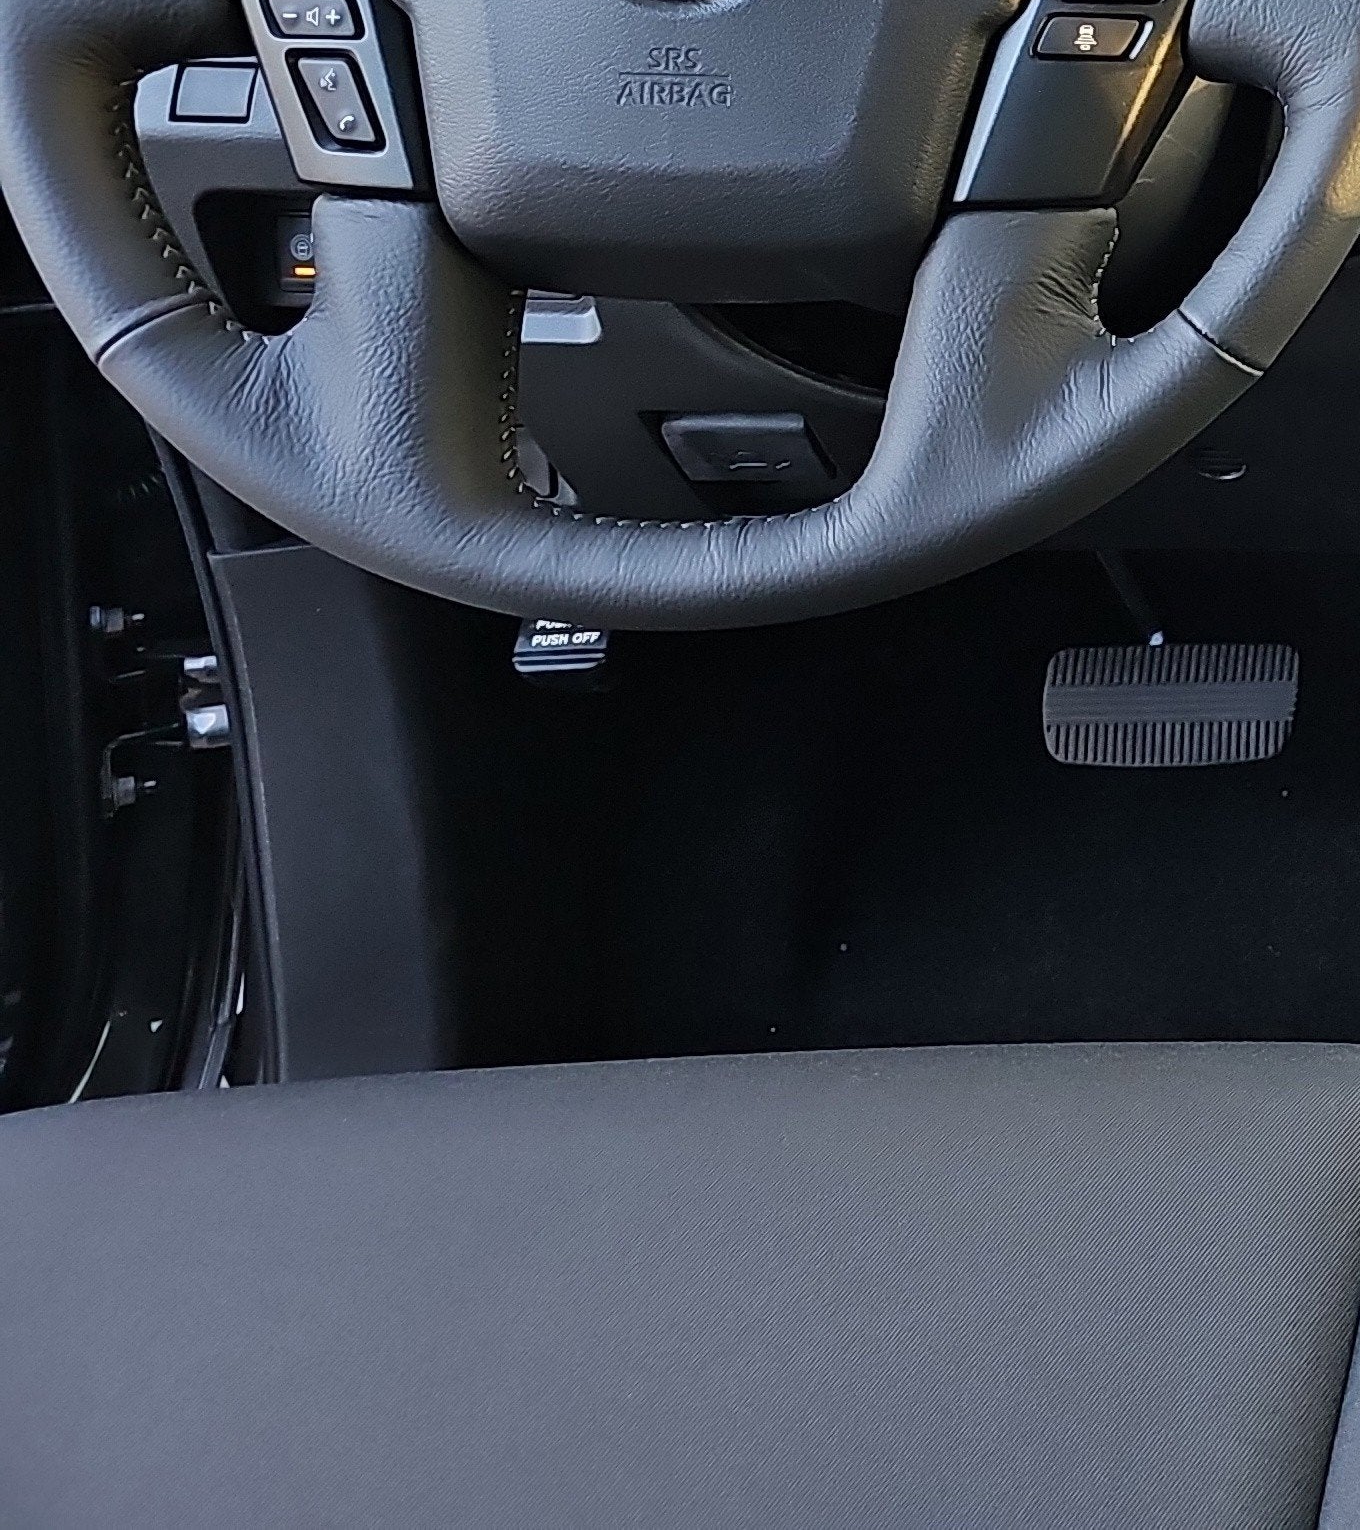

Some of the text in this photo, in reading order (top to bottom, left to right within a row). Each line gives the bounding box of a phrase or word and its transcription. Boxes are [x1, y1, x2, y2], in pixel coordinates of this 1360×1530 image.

[647, 46, 703, 71] SRS
[616, 79, 733, 107] AIRBAG
[531, 631, 601, 647] PUSH OFF
